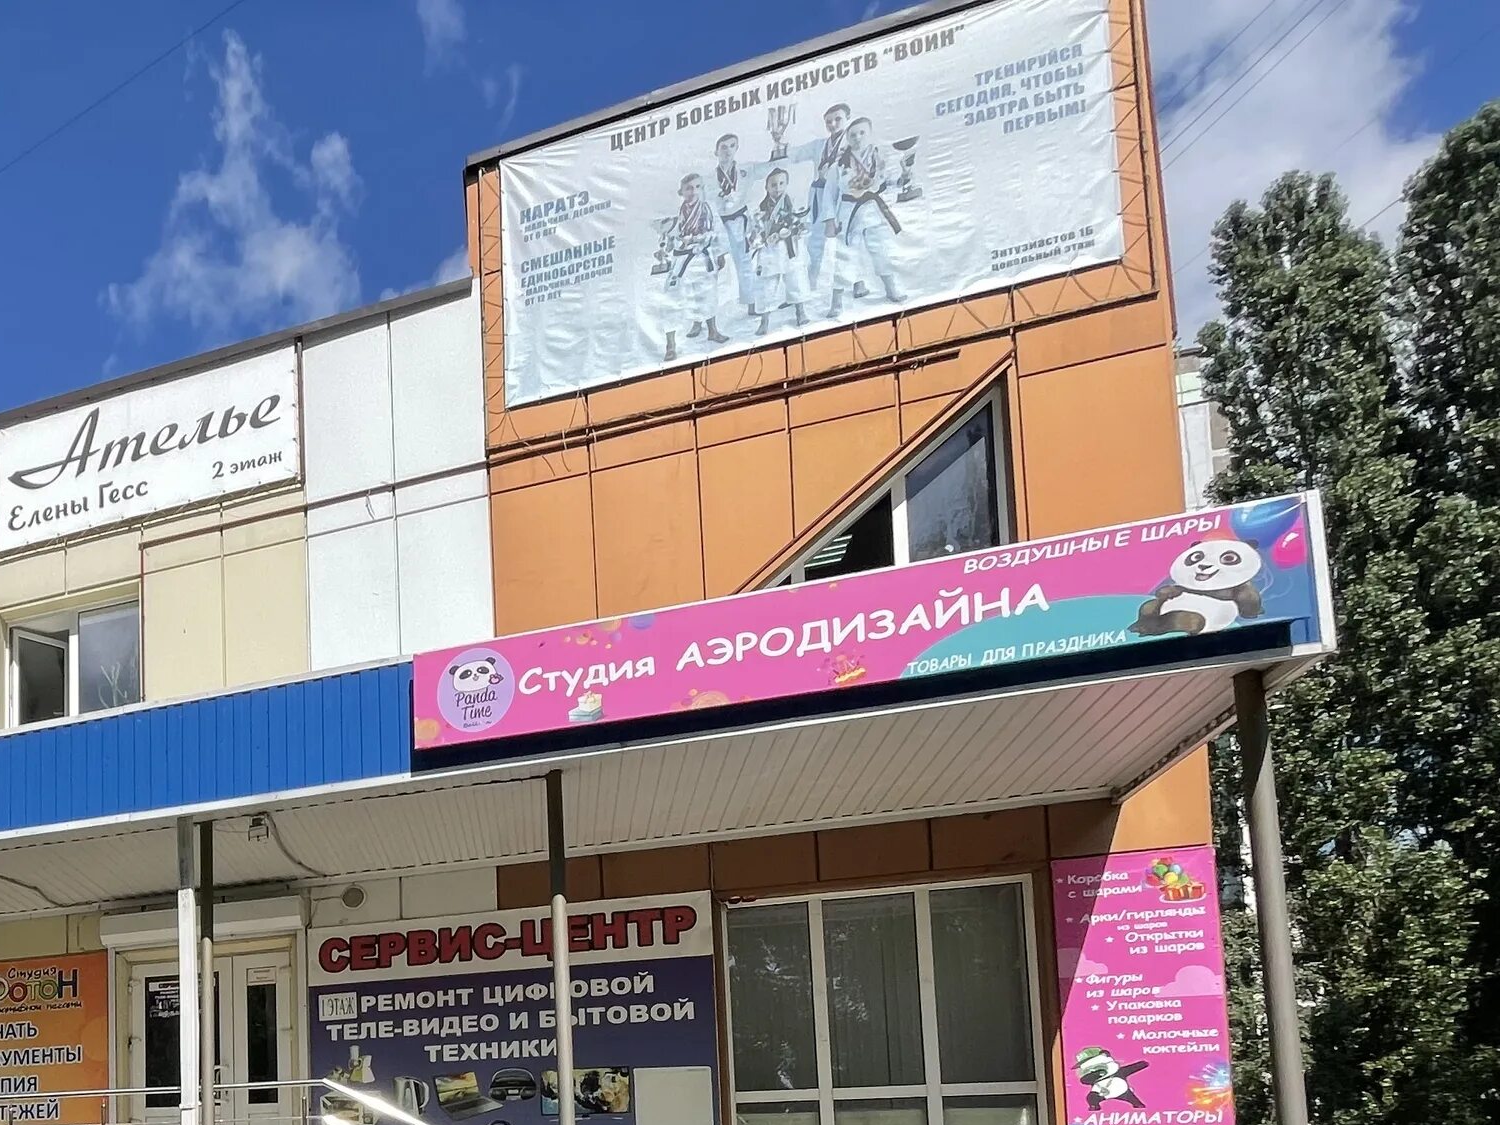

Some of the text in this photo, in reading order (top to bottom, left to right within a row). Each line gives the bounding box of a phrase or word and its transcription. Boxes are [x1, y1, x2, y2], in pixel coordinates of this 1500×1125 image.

[974, 44, 1082, 86] ТРЕНИРУЙСЯ
[610, 114, 670, 151] ЦЕНТР
[676, 88, 760, 130] БОЕВЫХ
[767, 51, 877, 105] ИСКУССТВ
[935, 63, 1084, 117] СЕГОДНЯ, ЧТОБЫ
[964, 82, 1085, 126] ЗАВТРА БЫТЬ
[1003, 99, 1086, 134] ПЕРВЫМ!
[519, 190, 590, 225] КАРАТЭ
[520, 235, 616, 274] СМЕШАННЫЕ
[520, 253, 614, 288] ЕДИНОБОРСТВА
[7, 394, 281, 490] Ателье
[212, 451, 283, 480] 2 этаж
[7, 496, 90, 531] Елены
[98, 480, 149, 508] Гесс
[962, 515, 1222, 575] ВОЗДУШНЫЕ ШАРЫ
[518, 583, 1051, 698] Студия АЭРОДИЗАЙНА
[906, 629, 1128, 677] ТОВАРЫ ДЛЯ ПРАЗДНИКА
[455, 686, 498, 707] Panda
[462, 704, 492, 720] Time
[1067, 871, 1129, 885] Коробка
[1068, 884, 1142, 899] с шарами
[1080, 906, 1206, 926] Арки/гирлянды
[1134, 921, 1168, 931] шаров
[318, 905, 697, 973] СЕРВИС-ЦЕНТР
[1125, 929, 1204, 943] Открытки
[1129, 941, 1205, 955] из шаров
[7, 967, 57, 980] Студия
[1085, 973, 1143, 986] Фигуры
[361, 988, 473, 1013] РЕМОНТ
[1086, 986, 1161, 998] из шаров
[328, 996, 354, 1016] ЭТАЖ
[1106, 1000, 1182, 1012] Упаковка
[326, 998, 695, 1042] ТЕЛЕ-ВИДЕО И БЫТОВОЙ
[1108, 1013, 1183, 1025] подарков
[1132, 1028, 1219, 1041] Молочные
[424, 1038, 557, 1063] ТЕХНИКИ
[1143, 1041, 1220, 1055] коктейли
[1084, 1110, 1223, 1125] АНИМАТОРЫ
